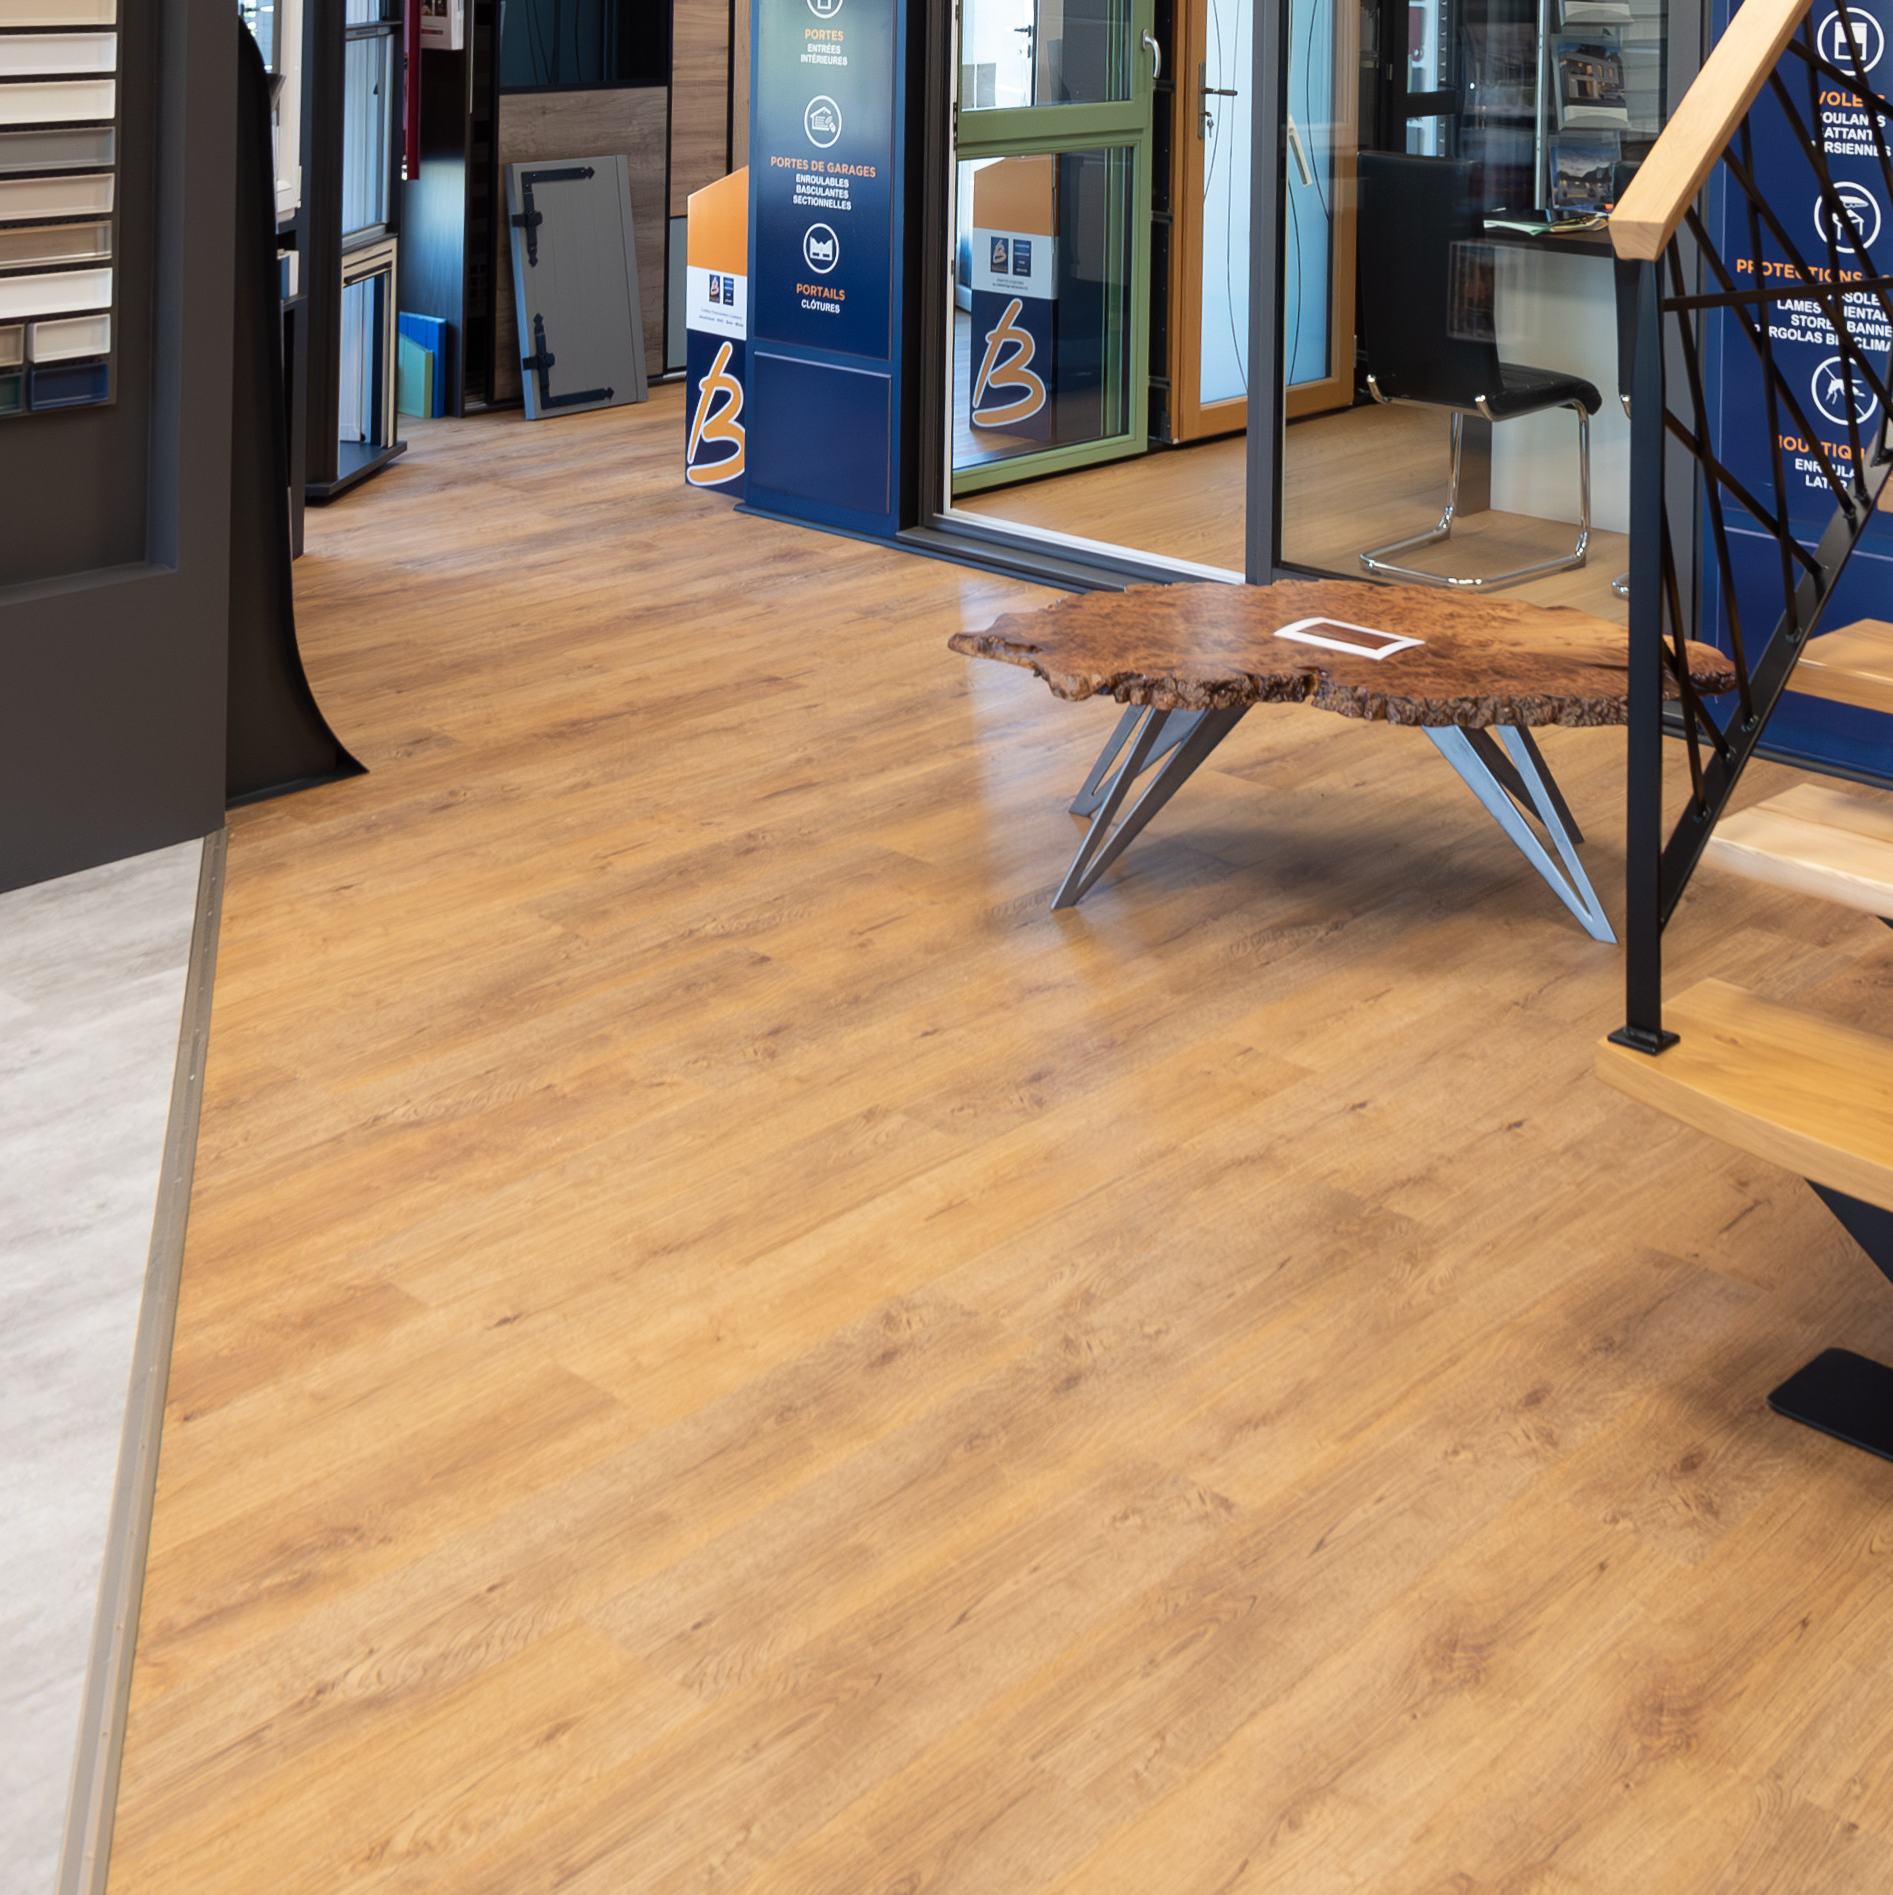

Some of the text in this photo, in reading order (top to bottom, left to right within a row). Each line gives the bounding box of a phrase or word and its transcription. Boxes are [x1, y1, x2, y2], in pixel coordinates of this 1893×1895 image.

[805, 29, 844, 42] PORTES
[807, 42, 841, 55] ENTRÉES
[800, 53, 848, 66] INTÉRIEURES
[1820, 111, 1886, 128] OULANS
[770, 156, 876, 178] PORTES DE GARAGES
[795, 174, 850, 188] ENROULABLES
[795, 185, 849, 199] BASCULANTES
[792, 195, 852, 211] SECTIONNELLES
[796, 283, 845, 301] PORTAILS
[801, 299, 840, 314] CLÔTURES
[1777, 299, 1822, 314] LAMES
[1791, 315, 1893, 338] STORE BANNE
